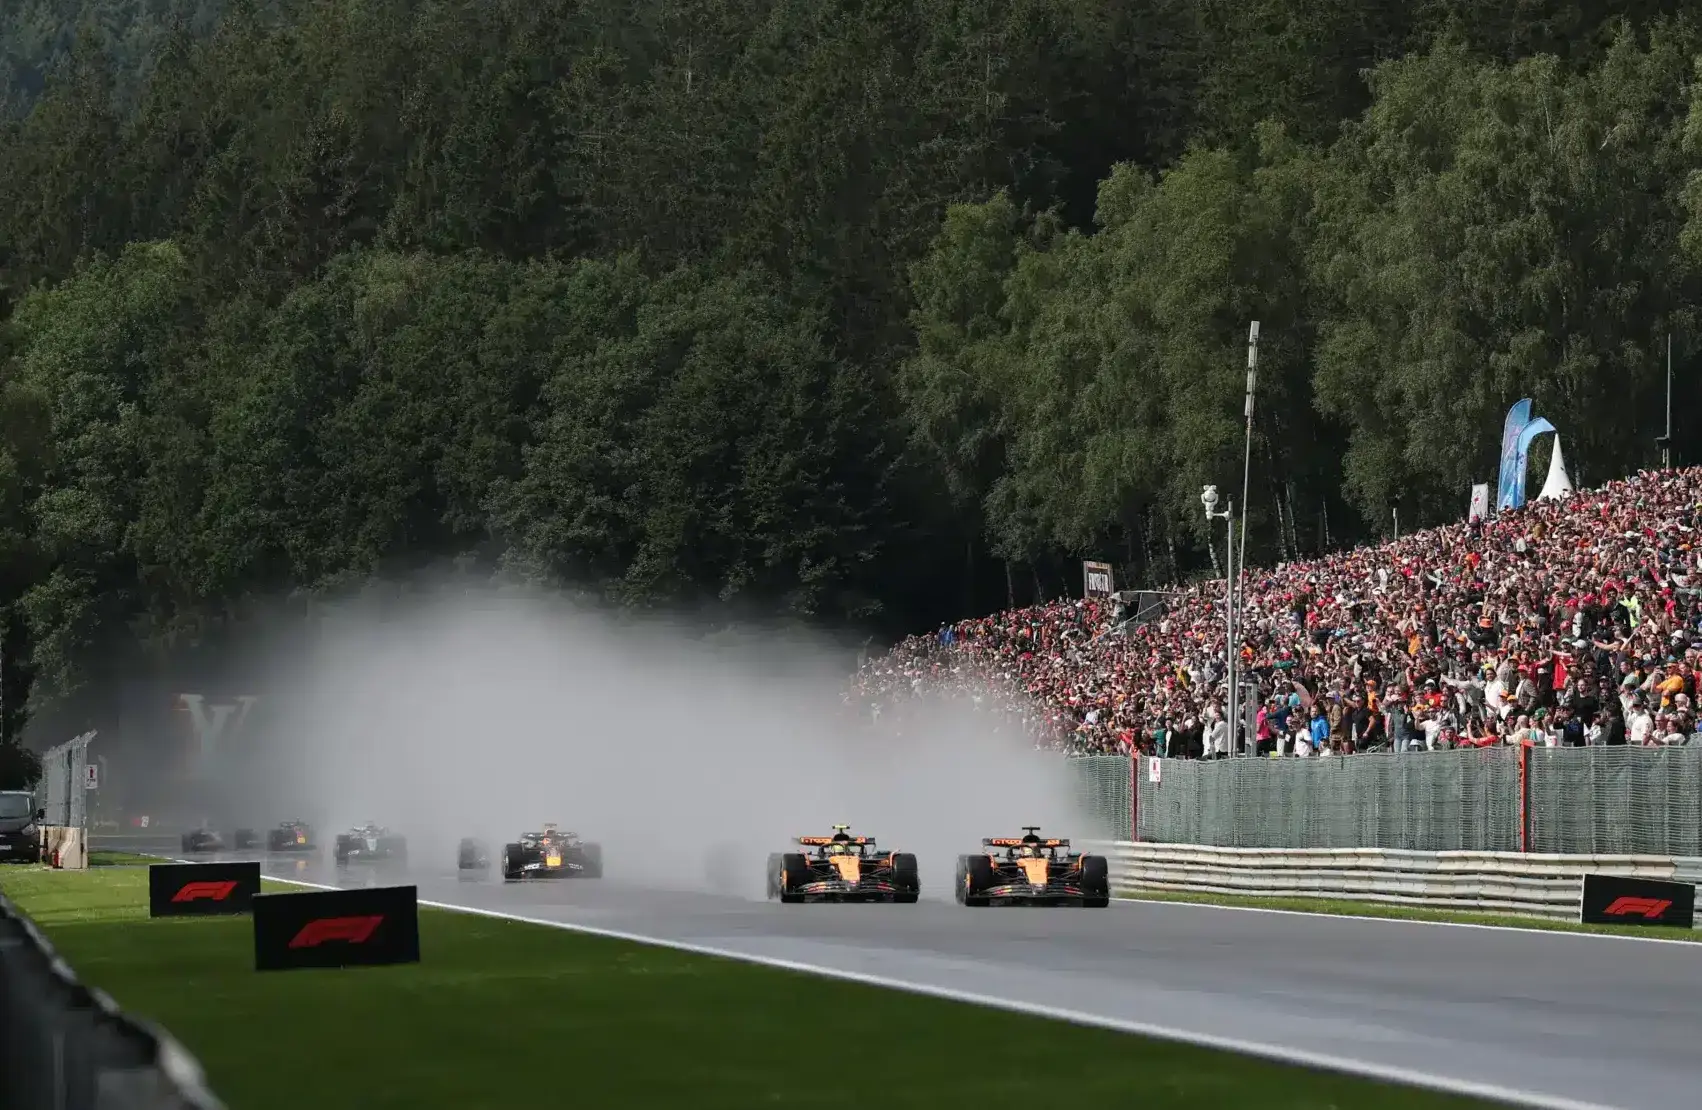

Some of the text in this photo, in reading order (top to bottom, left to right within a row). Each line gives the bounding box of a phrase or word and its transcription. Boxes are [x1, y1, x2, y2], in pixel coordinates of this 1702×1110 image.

[171, 881, 238, 902] F1
[1603, 897, 1672, 918] F1
[288, 916, 384, 948] F1
